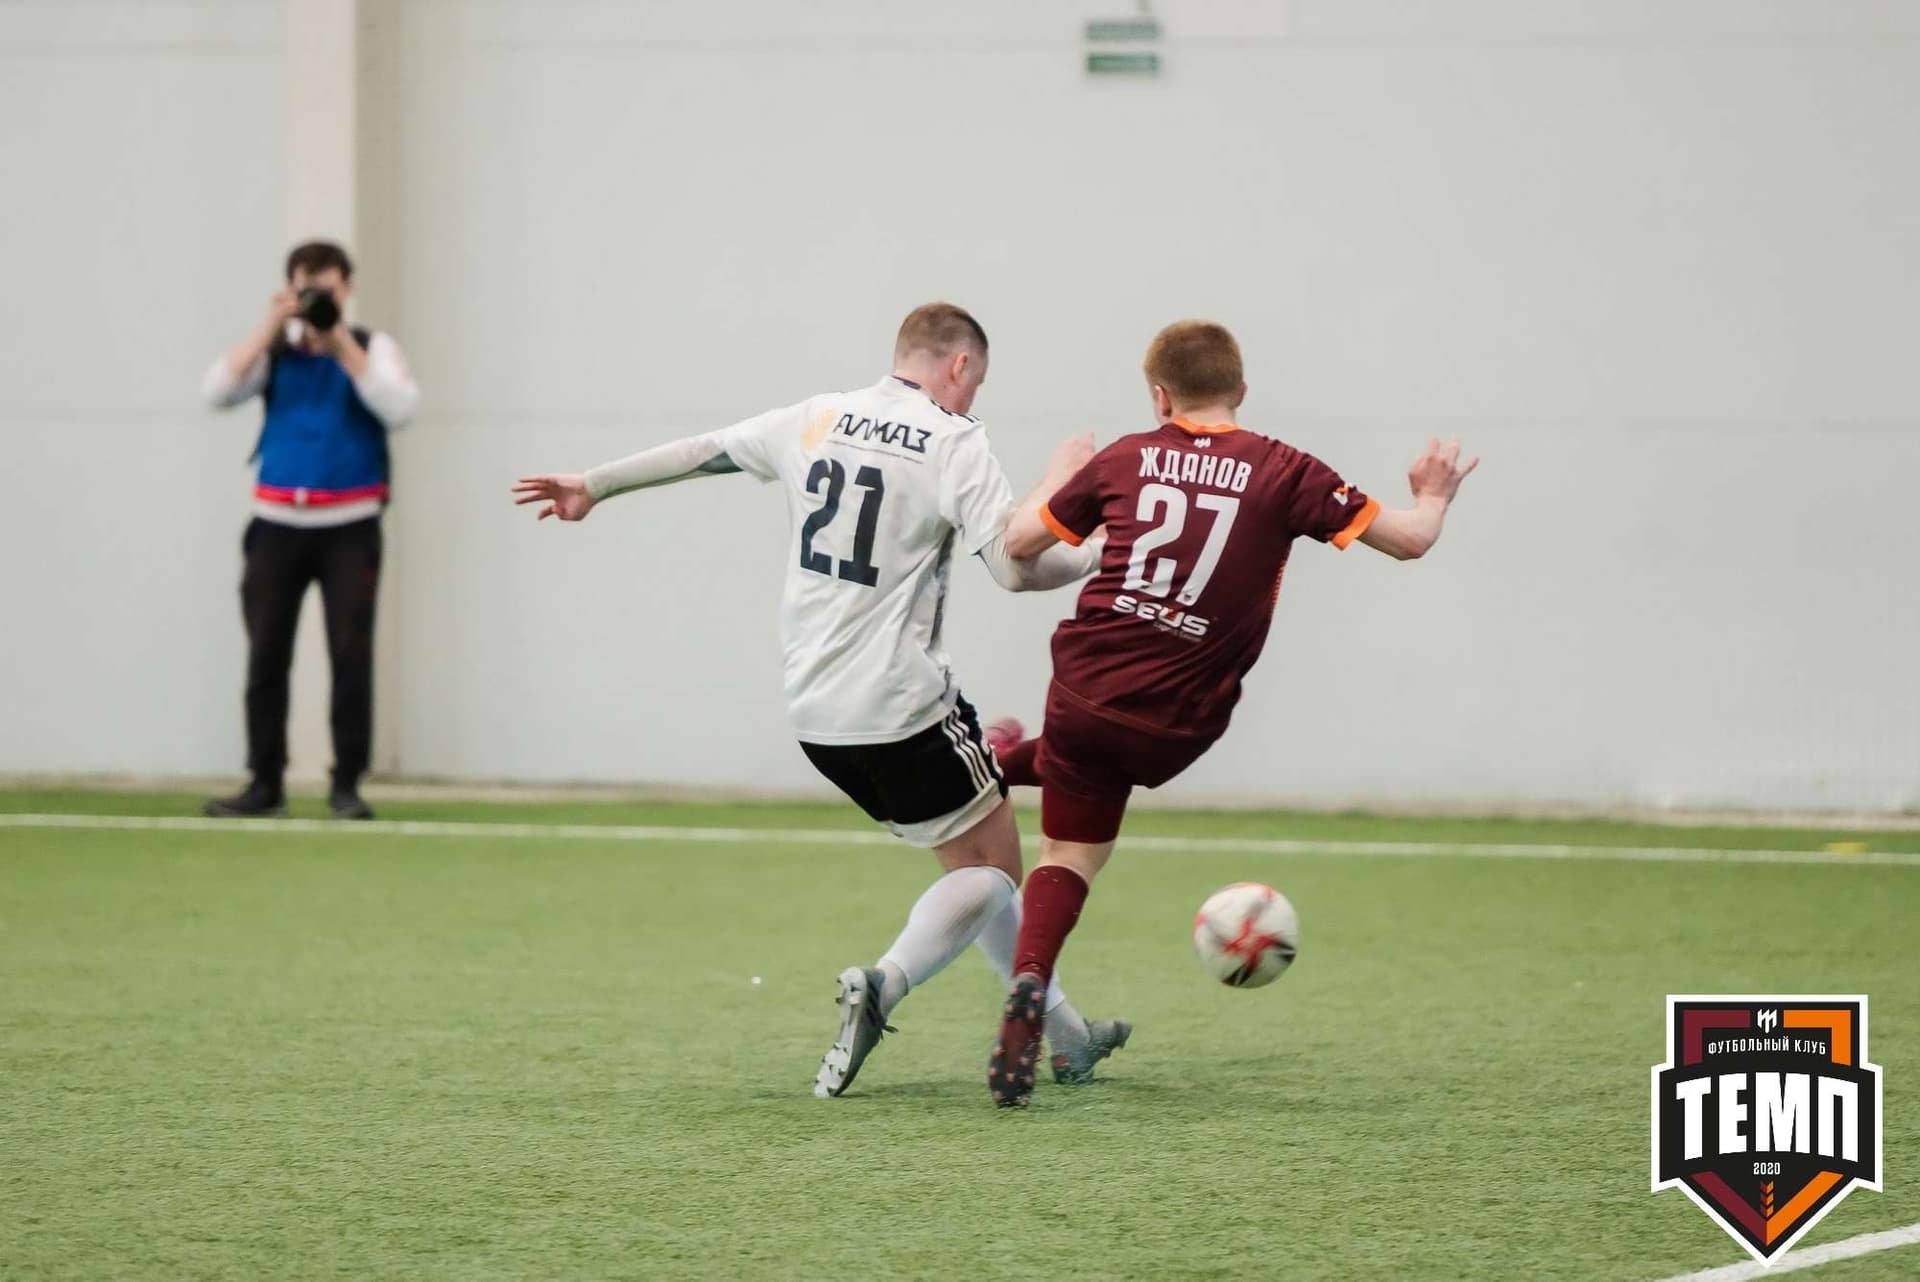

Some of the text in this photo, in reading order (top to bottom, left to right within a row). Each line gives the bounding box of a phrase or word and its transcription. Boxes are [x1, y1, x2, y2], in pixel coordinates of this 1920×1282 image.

[832, 413, 932, 454] АЛМАЗ
[1138, 446, 1252, 493] ЖДАНОВ
[800, 457, 885, 588] 21
[1122, 483, 1241, 607] 27
[1112, 594, 1210, 636] SEUS
